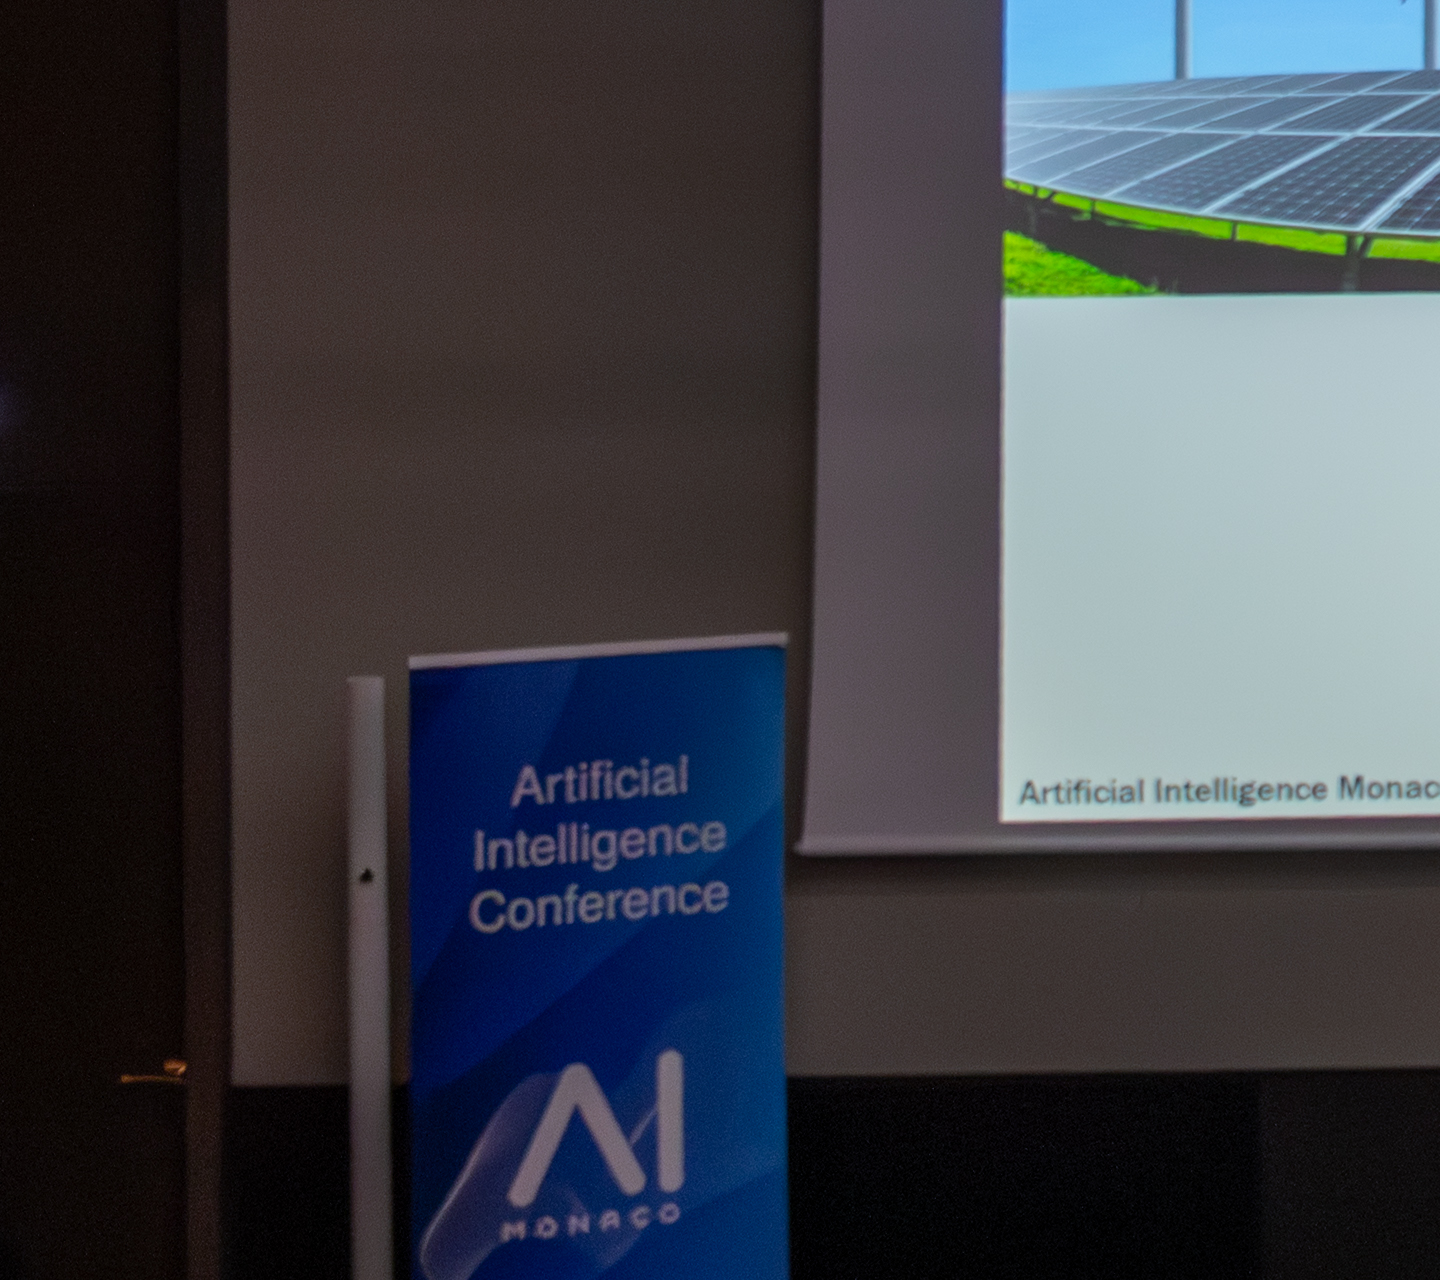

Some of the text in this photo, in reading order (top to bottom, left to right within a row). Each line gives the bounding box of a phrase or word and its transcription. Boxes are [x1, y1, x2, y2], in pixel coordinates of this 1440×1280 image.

[510, 754, 689, 808] Artificial
[1018, 778, 1146, 806] Artificial
[1153, 776, 1330, 808] Intelligence
[473, 820, 728, 872] Intelligence
[468, 880, 730, 934] Conference
[506, 1048, 685, 1208] AI
[501, 1201, 682, 1244] MONACO
